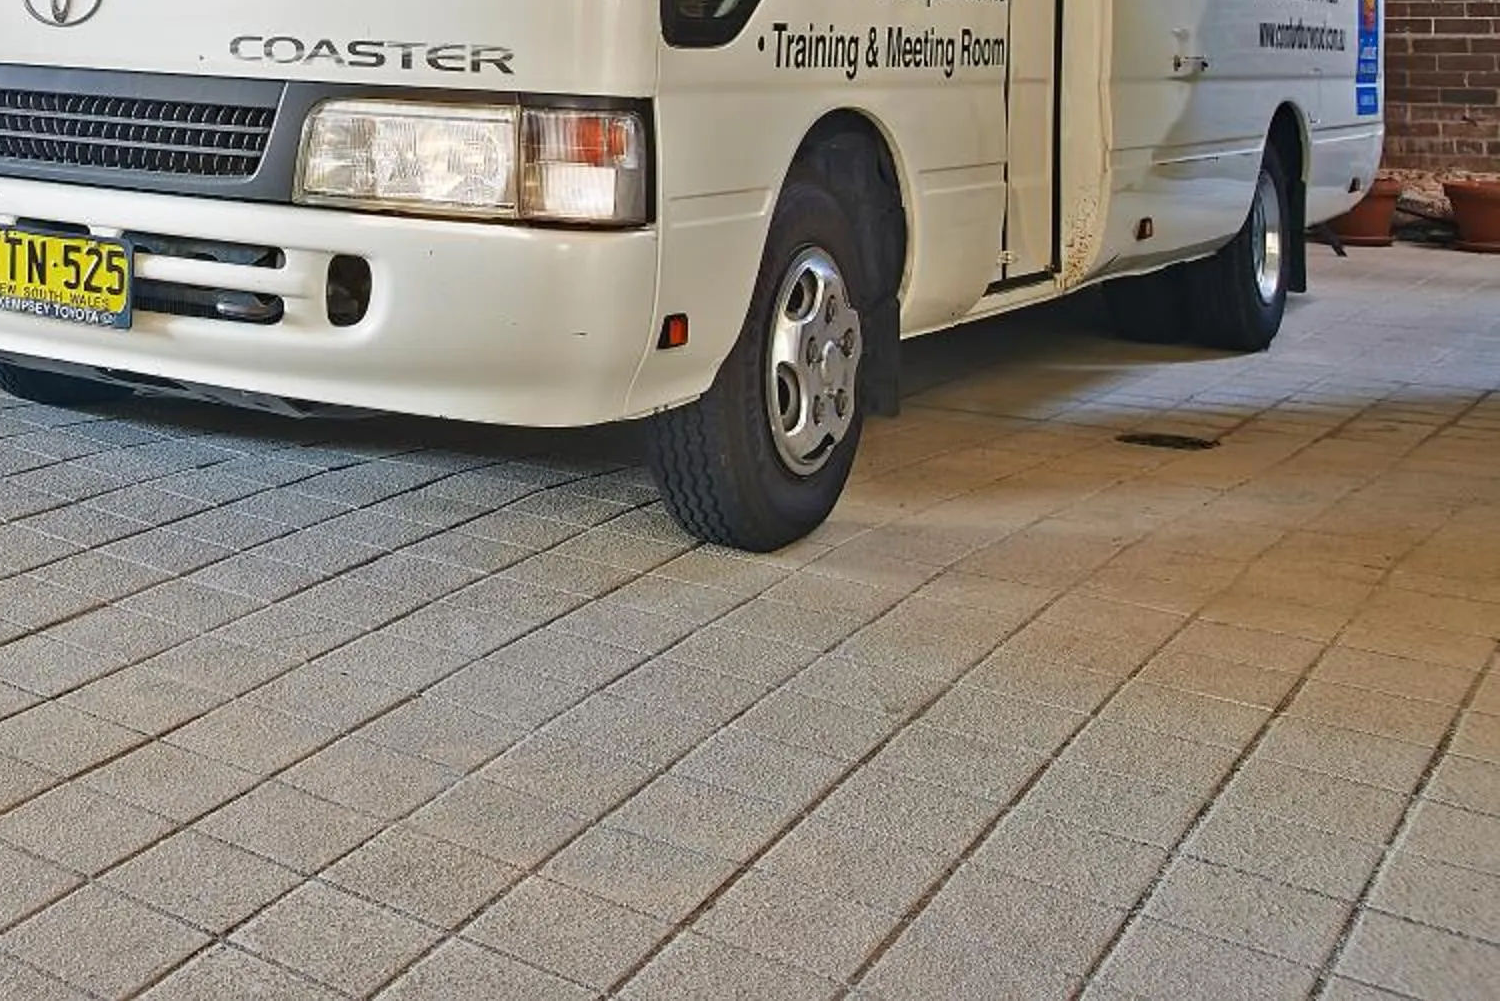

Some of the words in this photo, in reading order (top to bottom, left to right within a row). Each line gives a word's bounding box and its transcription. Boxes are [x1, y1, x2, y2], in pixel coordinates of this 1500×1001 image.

[229, 35, 515, 74] COASTER
[773, 23, 859, 80] Training
[865, 27, 879, 68] &
[886, 27, 955, 77] Meeting
[960, 28, 1005, 66] Room
[23, 286, 62, 302] SOUTH
[68, 293, 109, 309] WALES
[54, 304, 98, 323] TOYOTA
